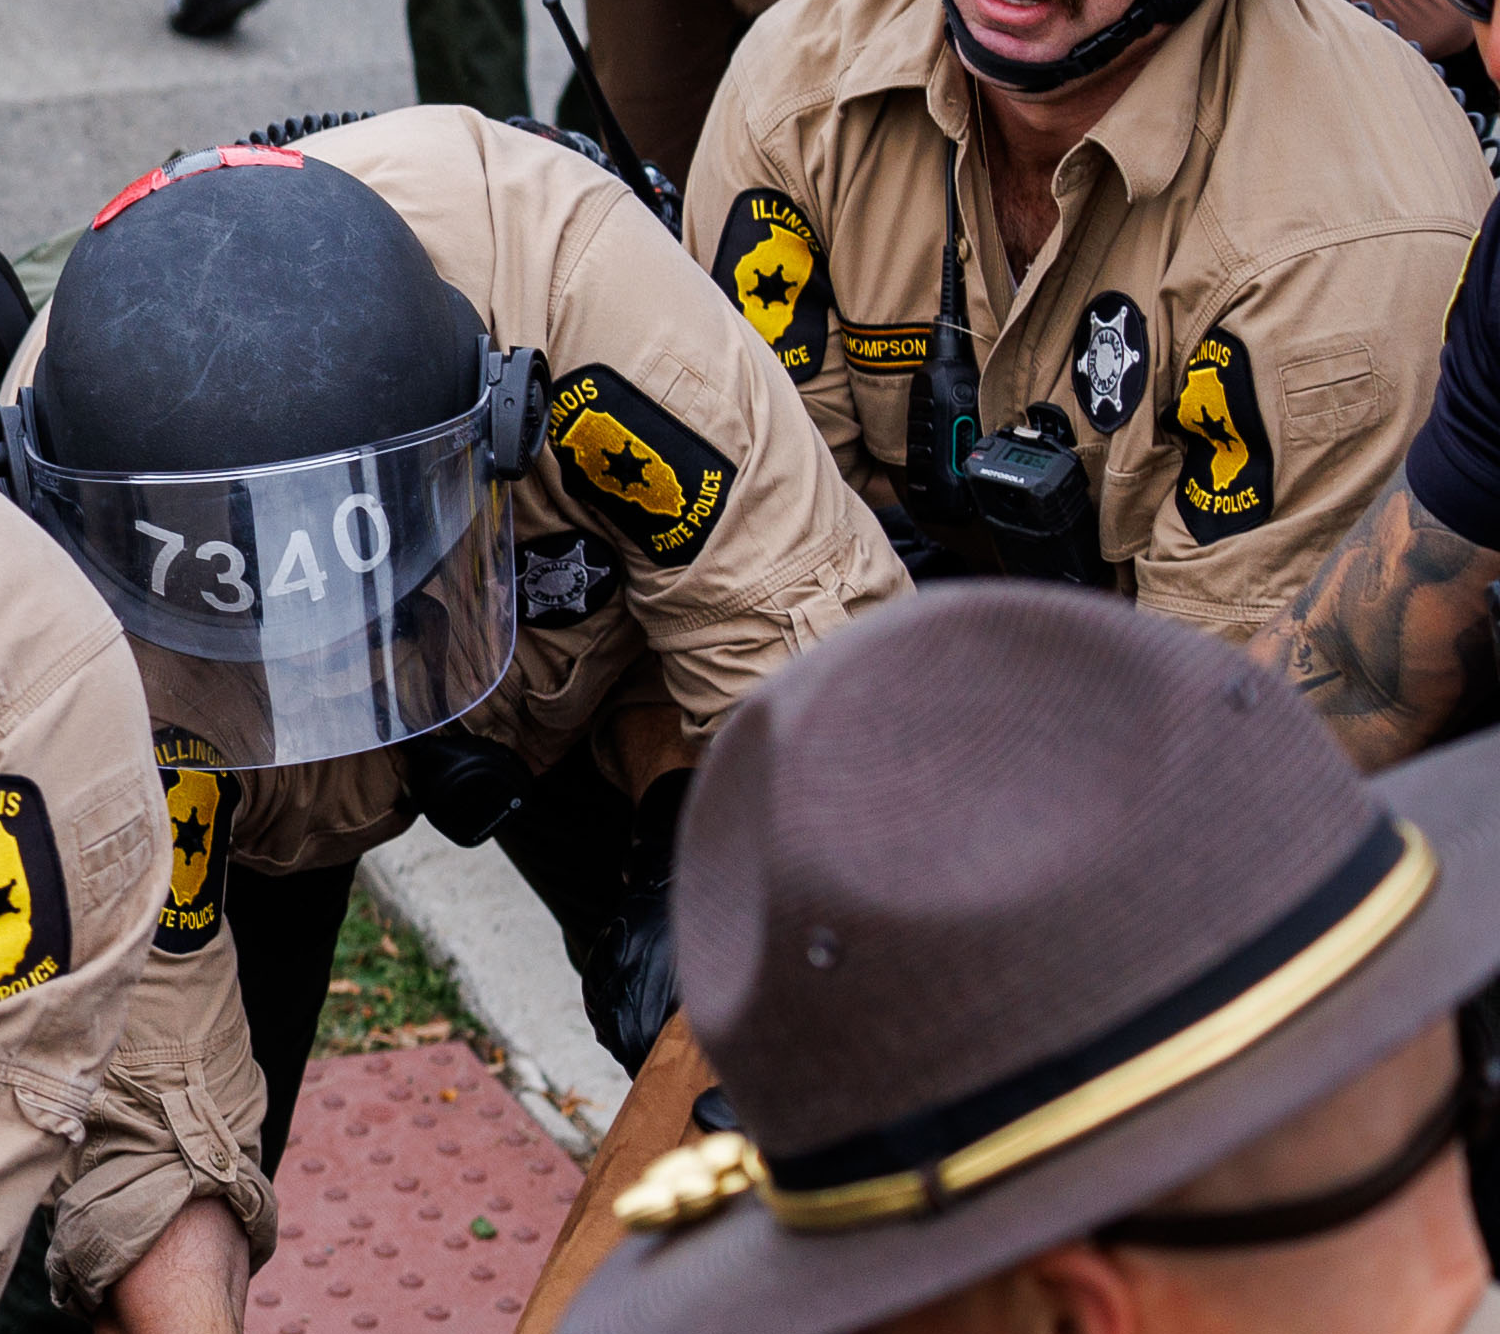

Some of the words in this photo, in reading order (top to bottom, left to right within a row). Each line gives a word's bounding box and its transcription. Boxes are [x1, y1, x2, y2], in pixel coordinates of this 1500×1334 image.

[778, 345, 811, 369] LICE
[844, 336, 927, 359] HOMPSON
[1189, 341, 1231, 367] LINOIS
[549, 378, 599, 446] LINOIS
[980, 468, 1024, 484] MOTOROLA
[652, 522, 692, 552] STATE
[686, 468, 722, 529] POLICE
[1185, 478, 1212, 512] STATE
[1213, 488, 1259, 514] POLICE
[135, 492, 392, 613] 7340
[180, 904, 216, 931] POLICE
[0, 956, 58, 1002] POLICE
